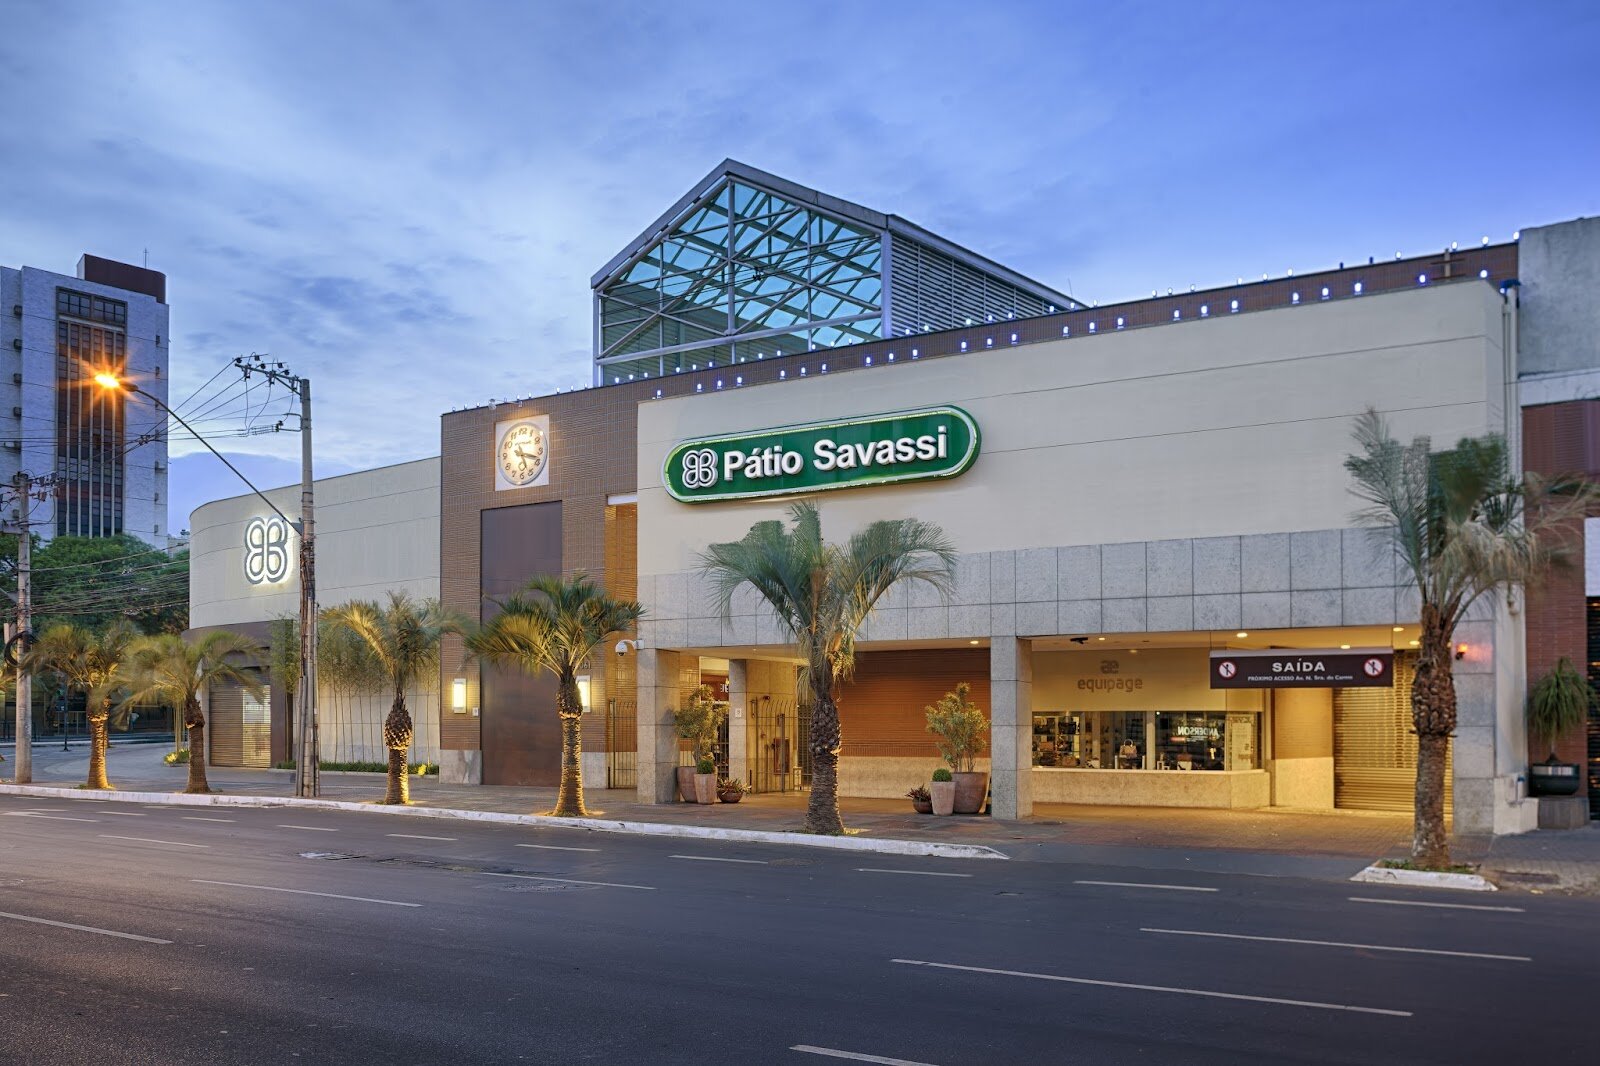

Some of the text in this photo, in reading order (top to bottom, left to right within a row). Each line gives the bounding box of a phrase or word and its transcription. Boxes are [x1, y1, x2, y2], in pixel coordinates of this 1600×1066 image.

[724, 425, 947, 481] Pátio Savassi
[1272, 658, 1326, 672] SAÍDA
[1077, 678, 1143, 693] equipage
